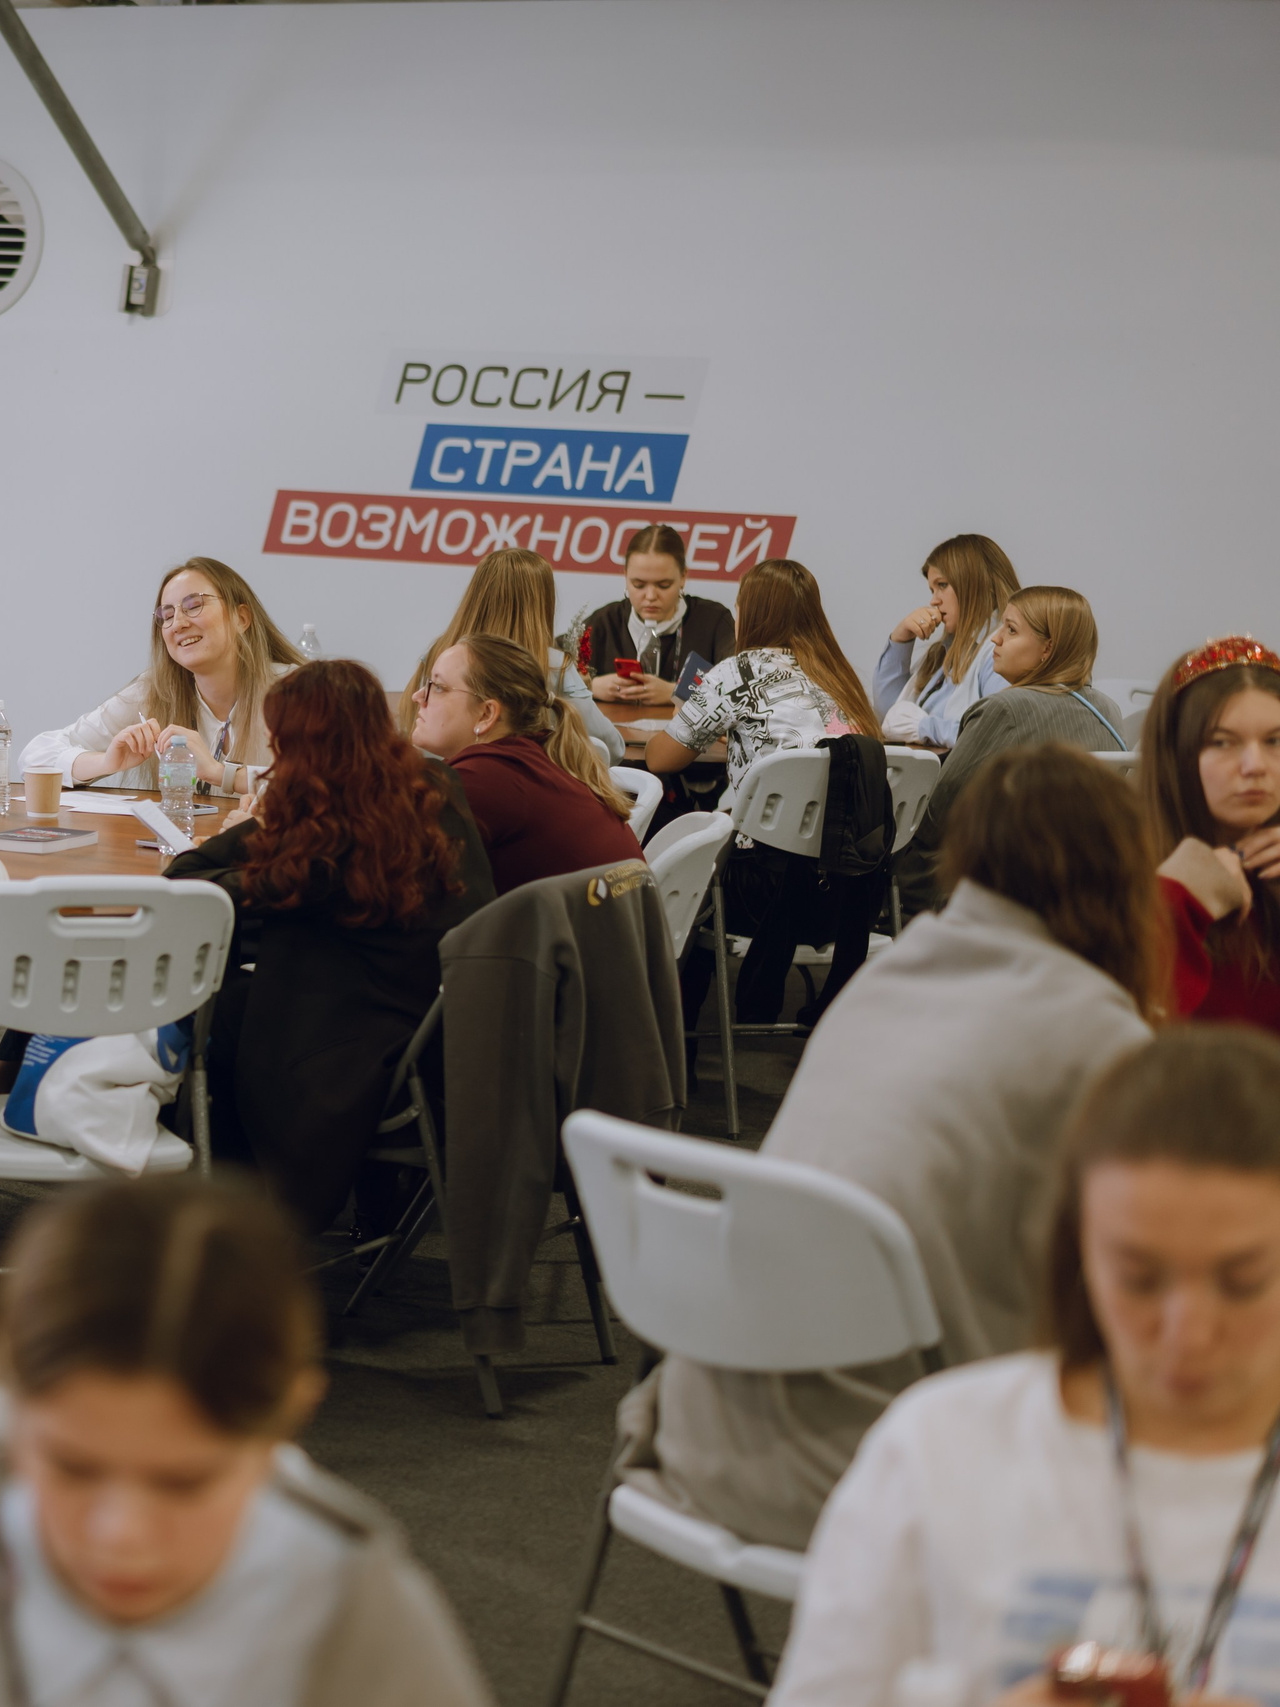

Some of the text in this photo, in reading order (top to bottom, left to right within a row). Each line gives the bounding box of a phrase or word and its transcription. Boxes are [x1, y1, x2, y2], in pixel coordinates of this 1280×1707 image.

[396, 363, 632, 413] РОССИЯ
[430, 438, 654, 494] СТРАНА
[280, 500, 773, 571] ВОЗМОЖНОСЕЙ
